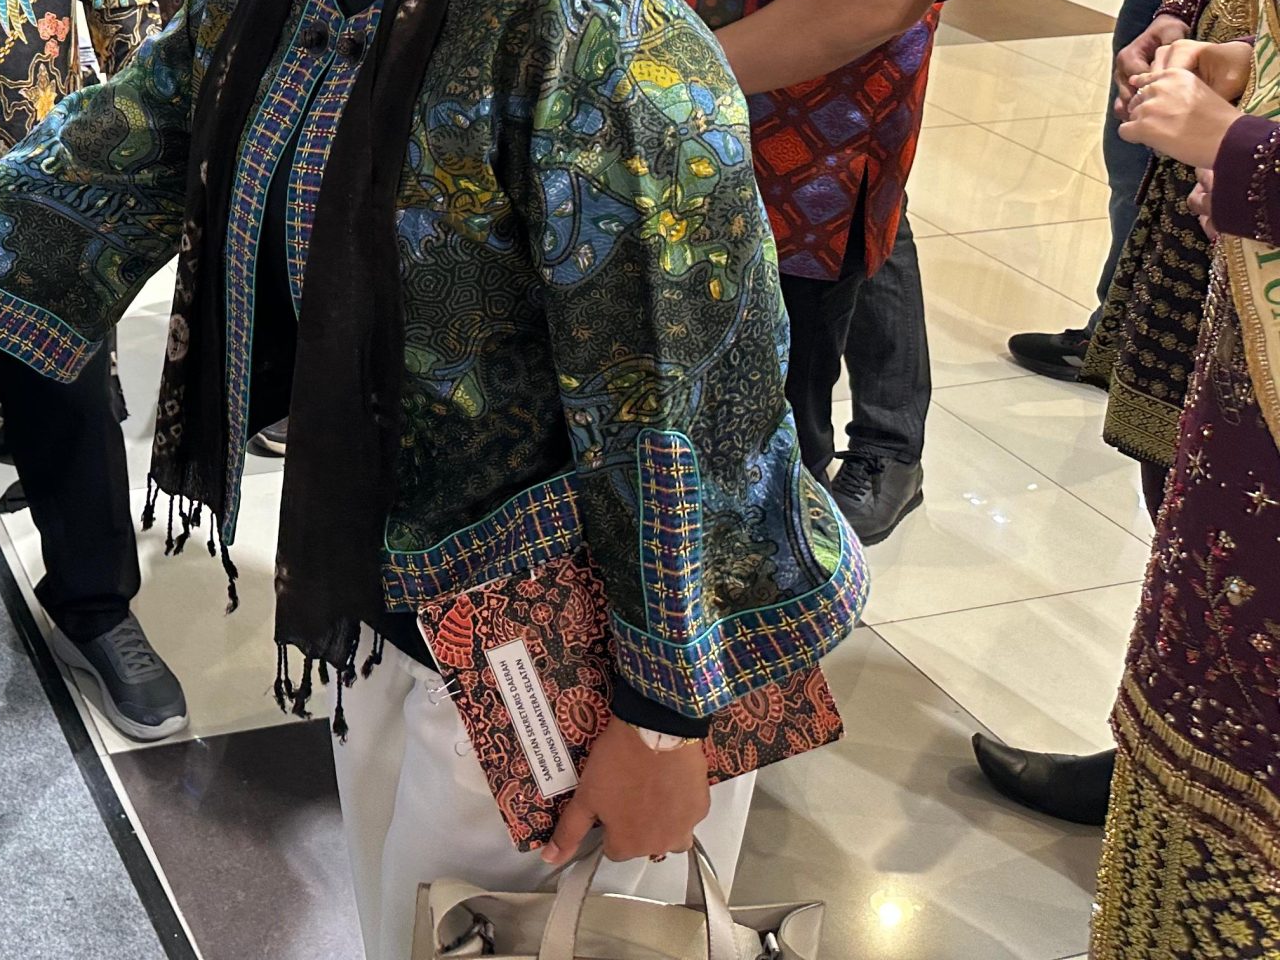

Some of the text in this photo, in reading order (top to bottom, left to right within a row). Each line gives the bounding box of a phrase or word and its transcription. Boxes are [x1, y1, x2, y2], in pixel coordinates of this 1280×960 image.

[499, 660, 553, 782] SAMBUTAN SEKRETARIS DAERAH
[515, 658, 565, 773] PROVINSI SUMATERA SELATAN
